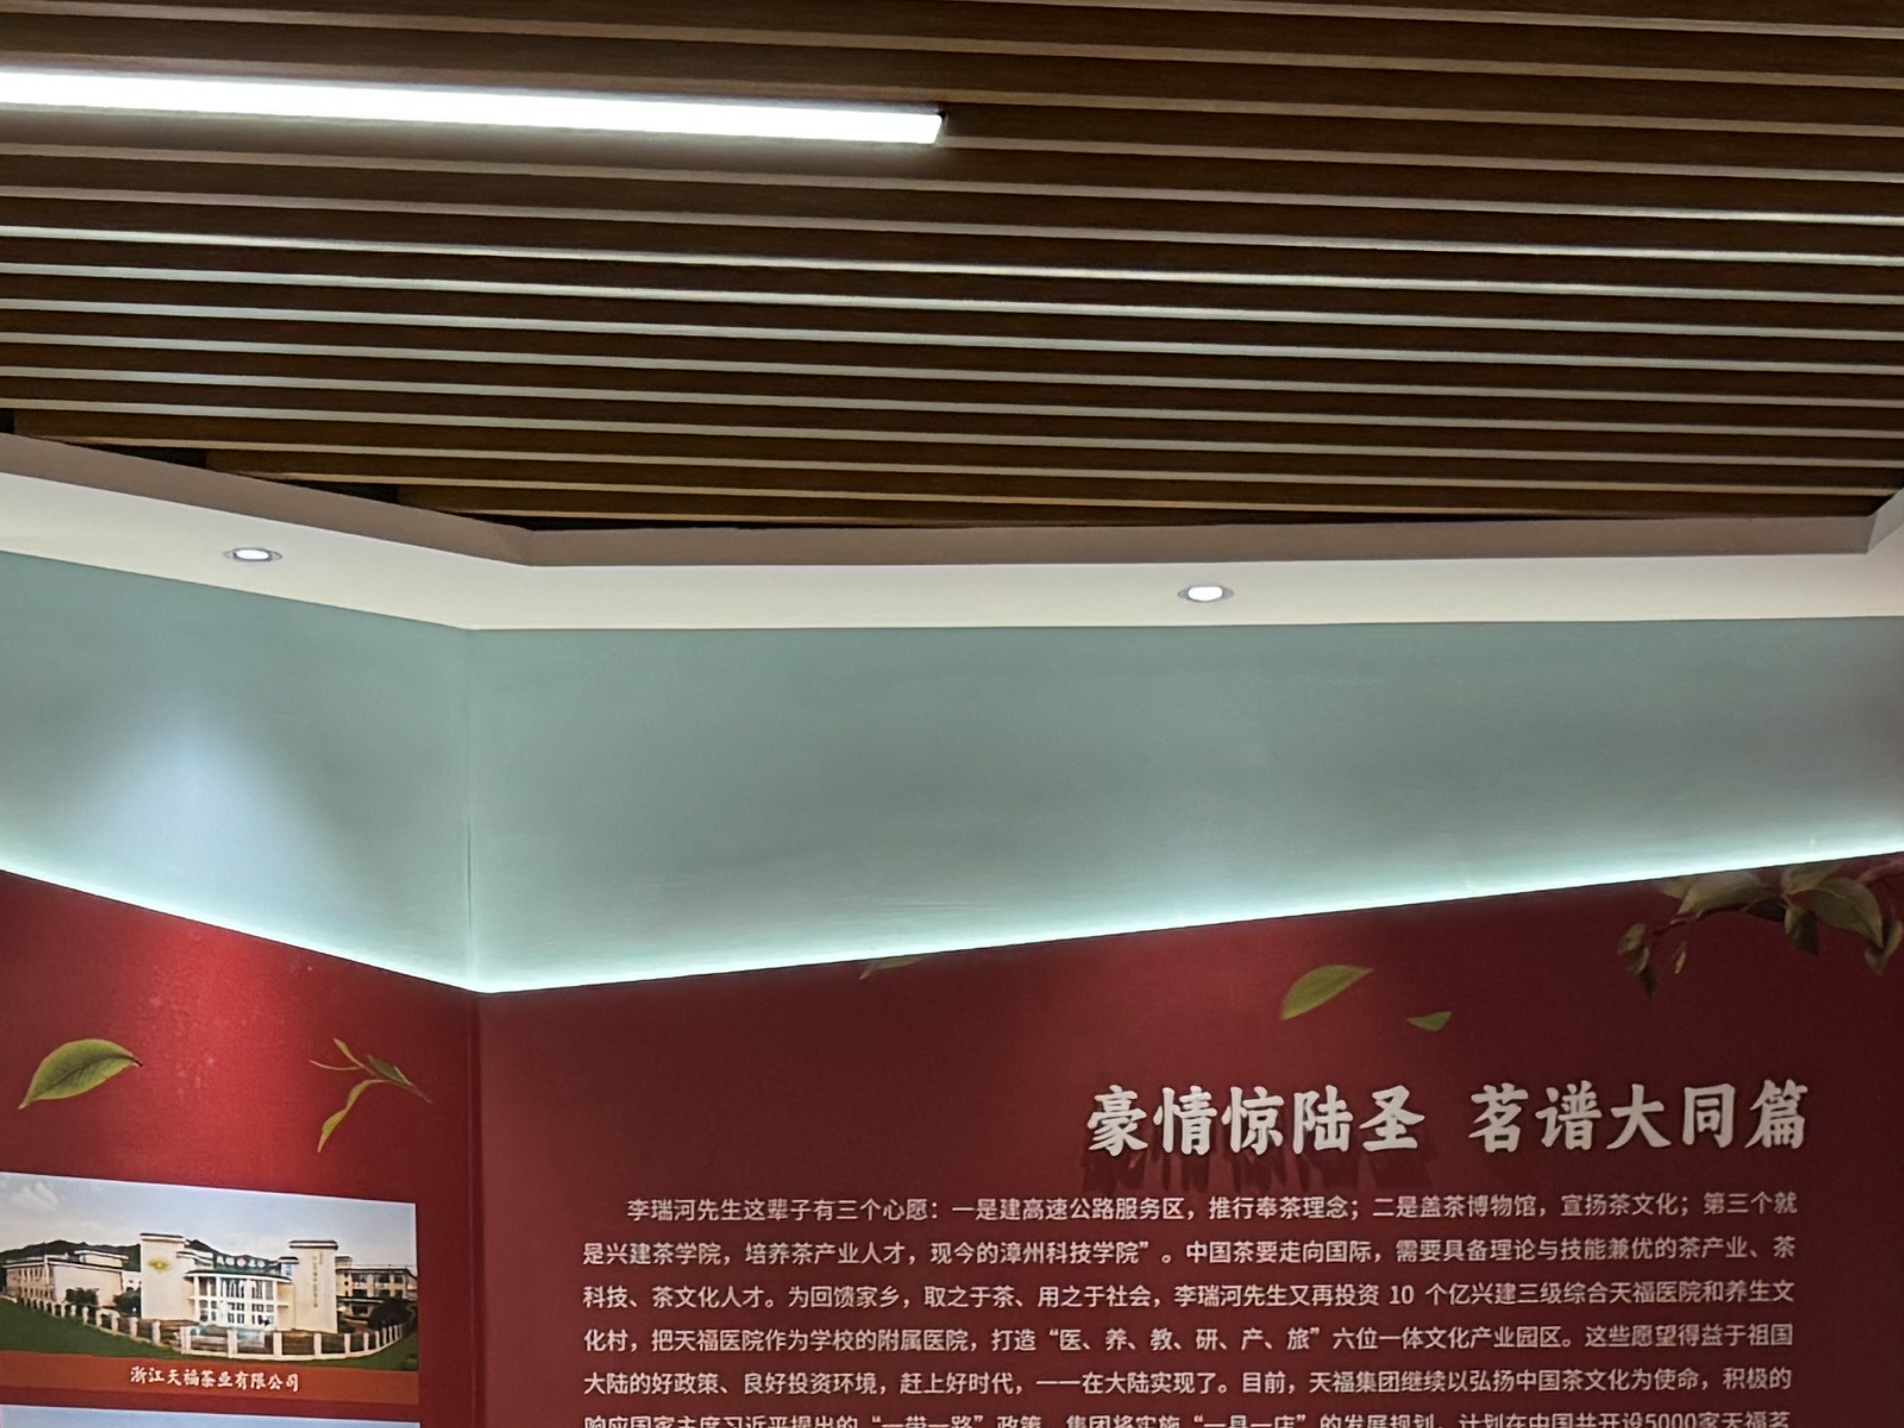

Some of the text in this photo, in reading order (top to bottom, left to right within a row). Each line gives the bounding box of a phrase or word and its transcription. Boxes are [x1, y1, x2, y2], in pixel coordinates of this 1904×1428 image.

[1085, 1078, 1810, 1157] 豪情惊陆圣 茗谱大同篇
[1388, 1283, 1415, 1306] 10
[130, 1365, 300, 1392] 浙江天福茶业有限公司
